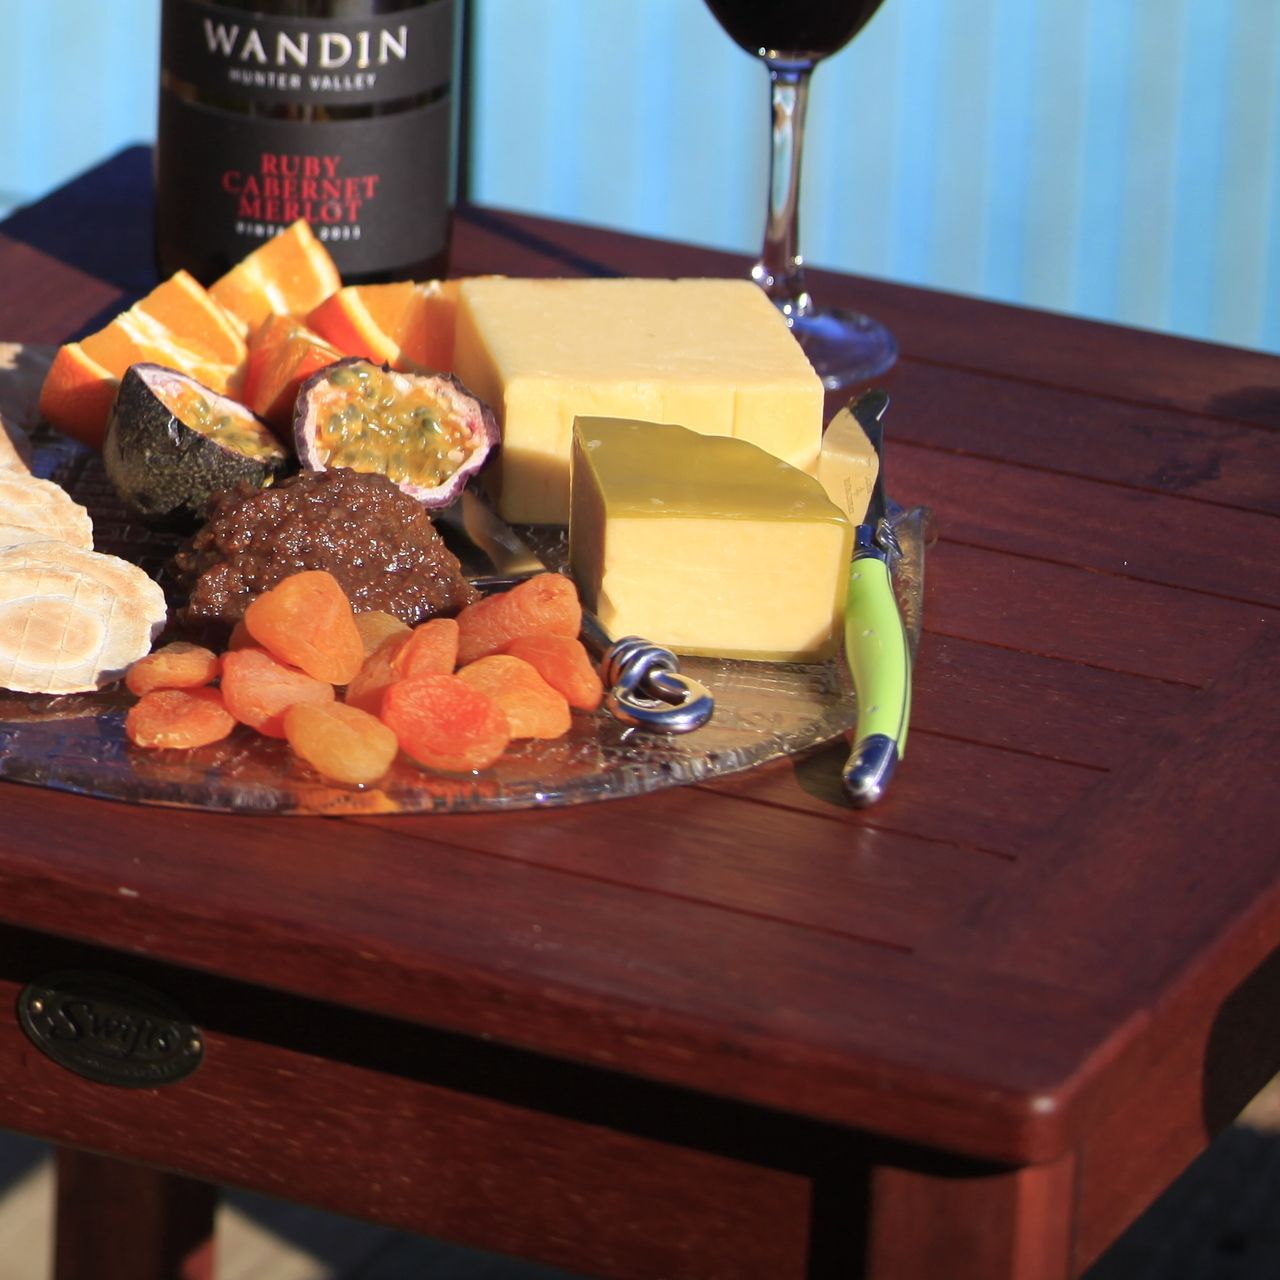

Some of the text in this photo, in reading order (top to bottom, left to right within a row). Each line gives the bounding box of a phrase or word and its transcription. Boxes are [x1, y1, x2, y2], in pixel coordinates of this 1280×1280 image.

[204, 19, 407, 69] WANDIN
[229, 69, 376, 91] HUNTER VALLEY
[261, 153, 341, 177] RUBY
[223, 171, 379, 199] CABERNET
[240, 197, 361, 223] MERLOT
